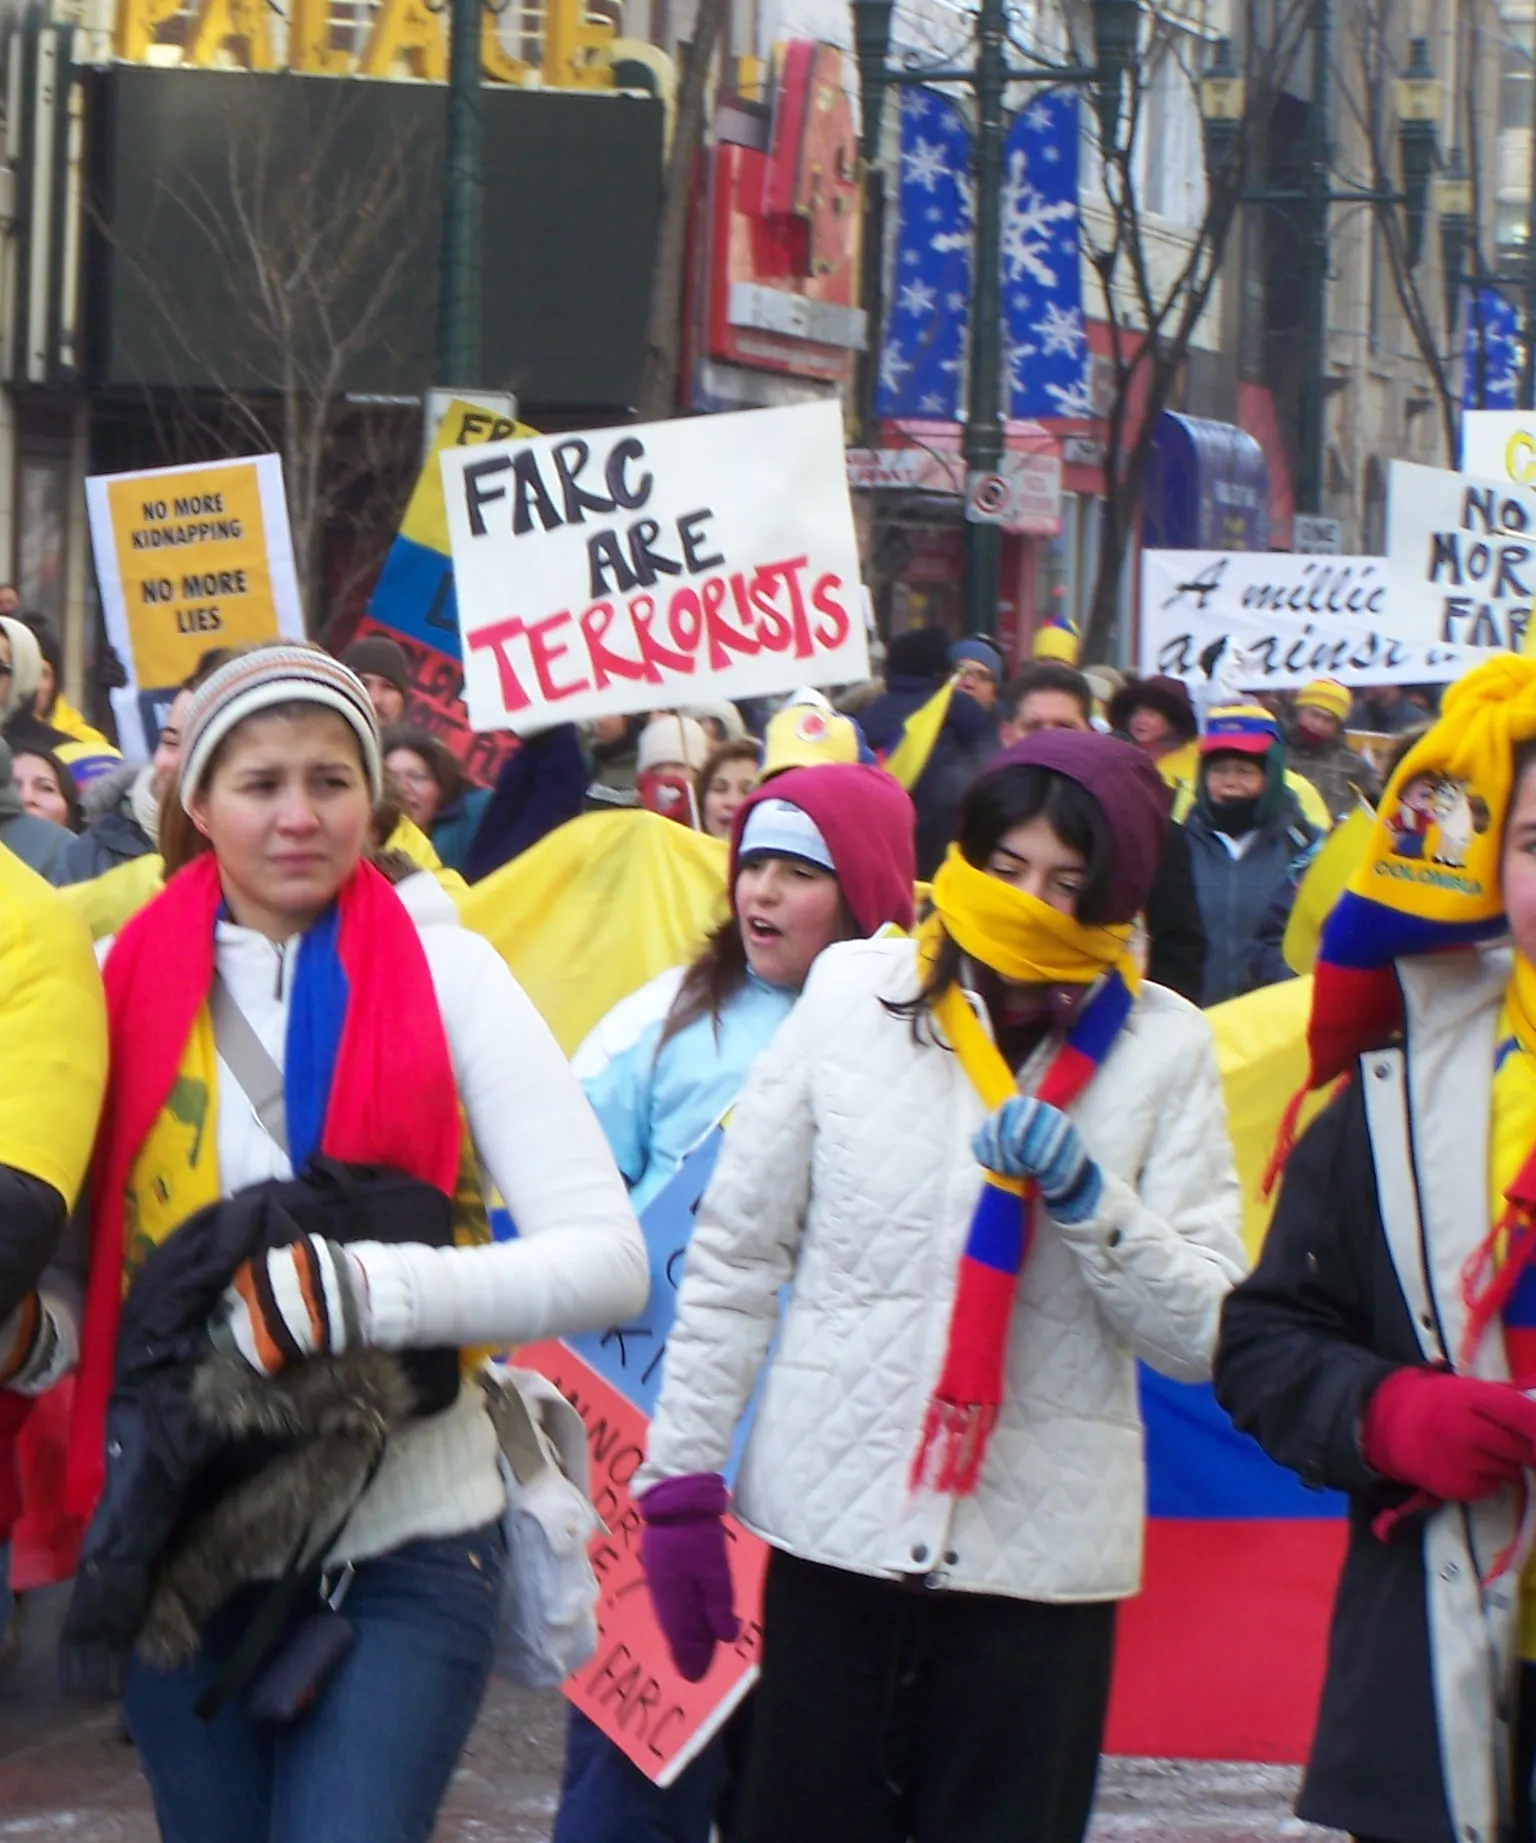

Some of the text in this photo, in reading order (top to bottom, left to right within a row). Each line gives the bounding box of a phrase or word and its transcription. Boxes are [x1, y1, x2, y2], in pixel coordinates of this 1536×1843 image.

[142, 493, 225, 521] NO MORE
[463, 437, 654, 537] FARC
[1460, 485, 1529, 535] NO
[131, 518, 242, 550] KIDNAPPING
[587, 508, 725, 599] ARE
[141, 569, 248, 604] NO MORE
[1161, 557, 1229, 610] A
[176, 607, 223, 634] LIES
[466, 555, 850, 713] TERRORISTS
[584, 1643, 688, 1762] FARC
